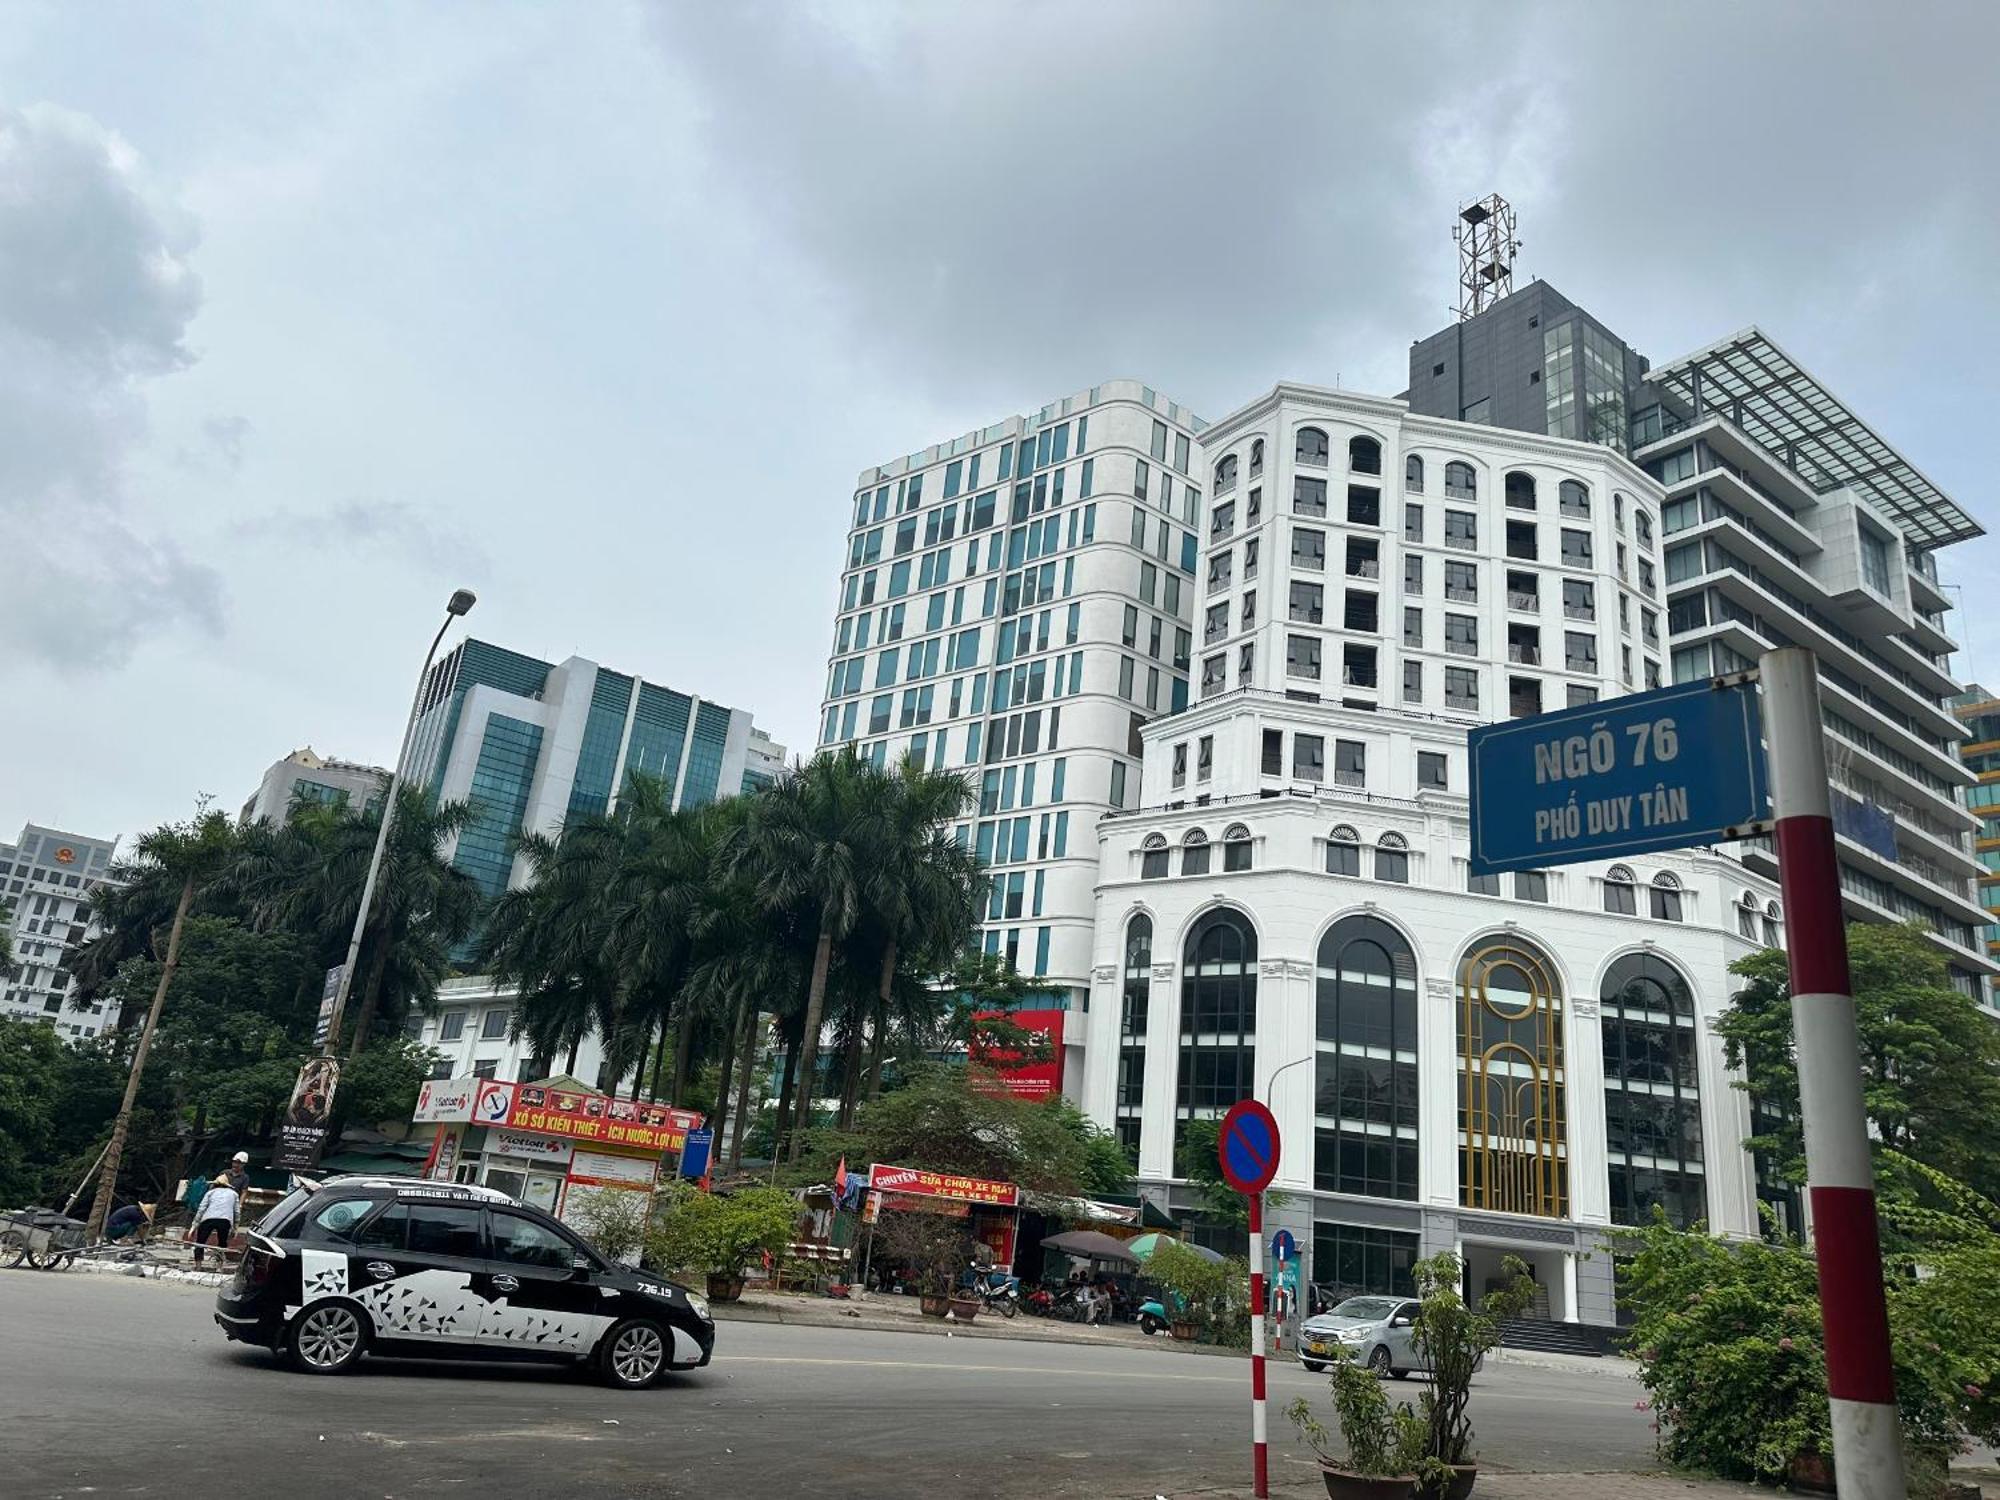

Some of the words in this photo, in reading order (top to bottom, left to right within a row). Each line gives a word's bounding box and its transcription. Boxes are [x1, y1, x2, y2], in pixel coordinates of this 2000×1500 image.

[1534, 721, 1616, 784] NGÕ
[1626, 717, 1679, 767] 76
[1535, 791, 1581, 843] PHỐ
[1587, 795, 1633, 836] DUY
[1638, 783, 1689, 827] TÂN
[512, 1107, 531, 1126] XỔ
[546, 1114, 572, 1133] KIẾN
[573, 1118, 601, 1137] THIẾT
[607, 1122, 626, 1140] ÍCH
[875, 1170, 918, 1187] CHUYÊN
[975, 1181, 989, 1192] XE
[637, 1282, 672, 1298] 736.19
